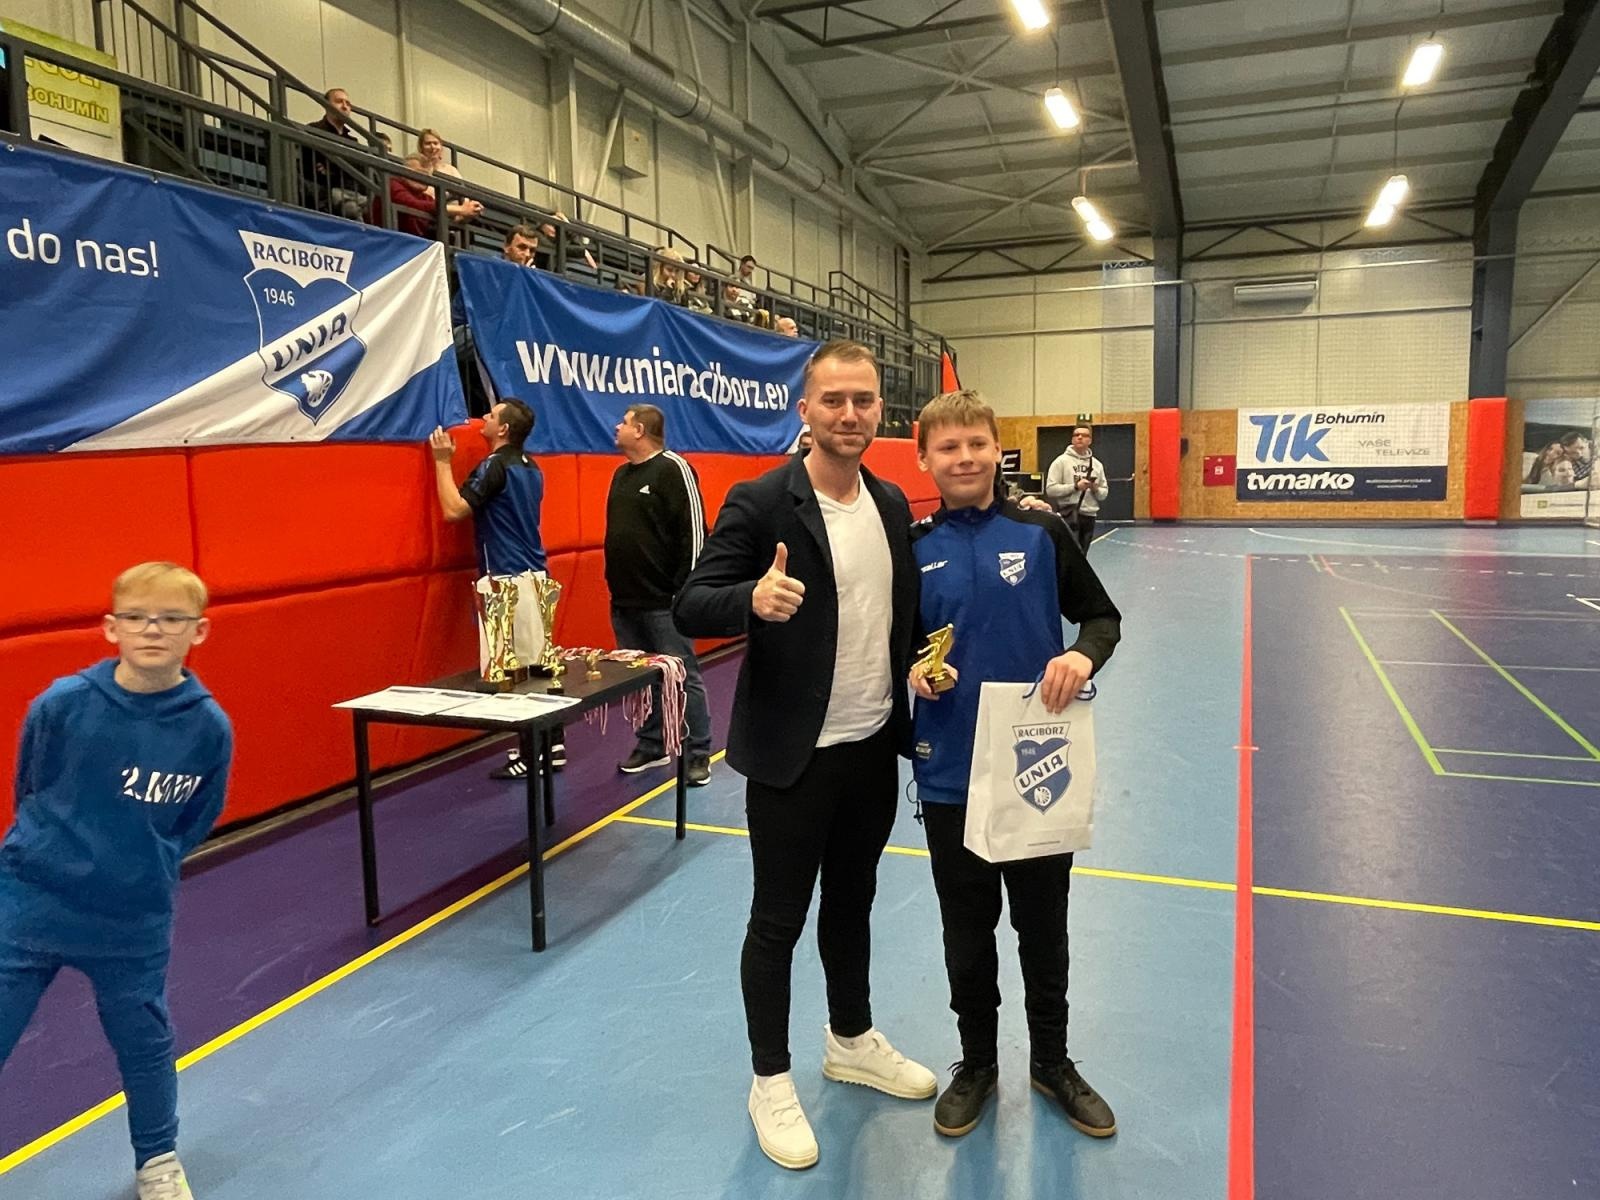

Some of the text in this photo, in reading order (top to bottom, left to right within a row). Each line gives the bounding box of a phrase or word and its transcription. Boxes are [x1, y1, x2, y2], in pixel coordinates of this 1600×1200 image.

[7, 219, 160, 278] do nas!
[252, 240, 346, 274] RACIBÓRZ
[263, 287, 296, 307] 1946
[271, 311, 348, 372] UNIA
[1314, 411, 1386, 425] Bohumín
[1246, 471, 1355, 490] tvmarko
[1019, 754, 1063, 788] UNIA
